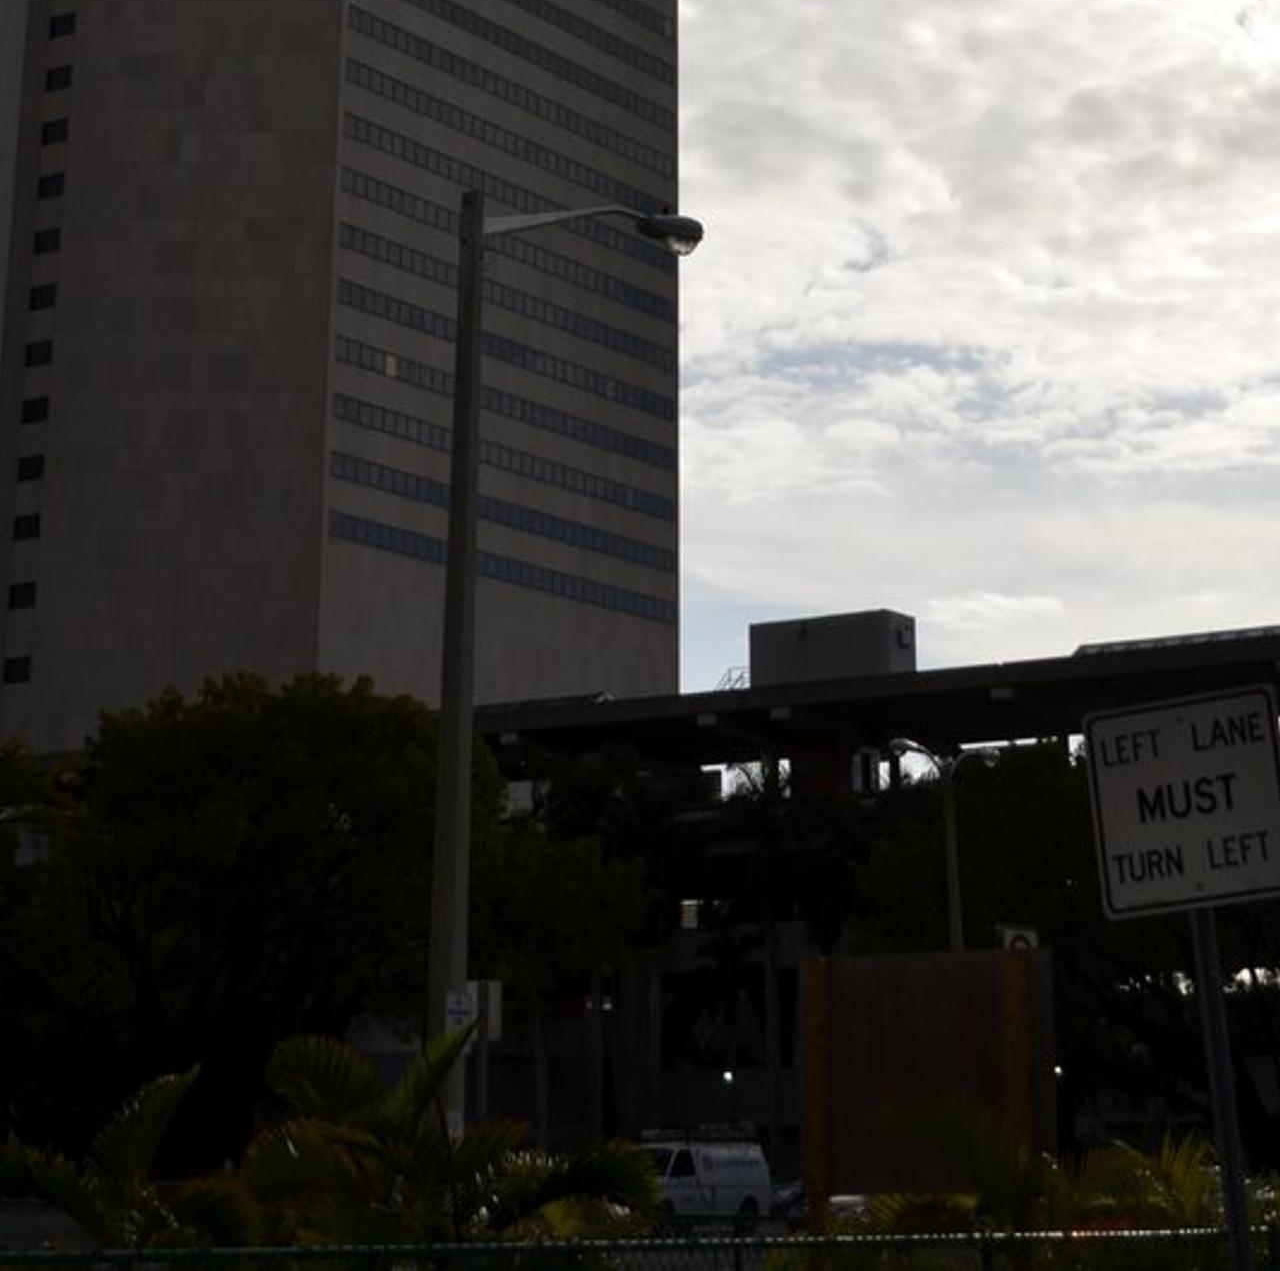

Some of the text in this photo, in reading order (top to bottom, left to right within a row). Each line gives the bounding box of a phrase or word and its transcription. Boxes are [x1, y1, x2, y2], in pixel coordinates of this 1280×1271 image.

[1100, 710, 1266, 768] LEFT LANE
[1136, 772, 1237, 824] MUST
[1112, 830, 1269, 885] TURN LEFT
